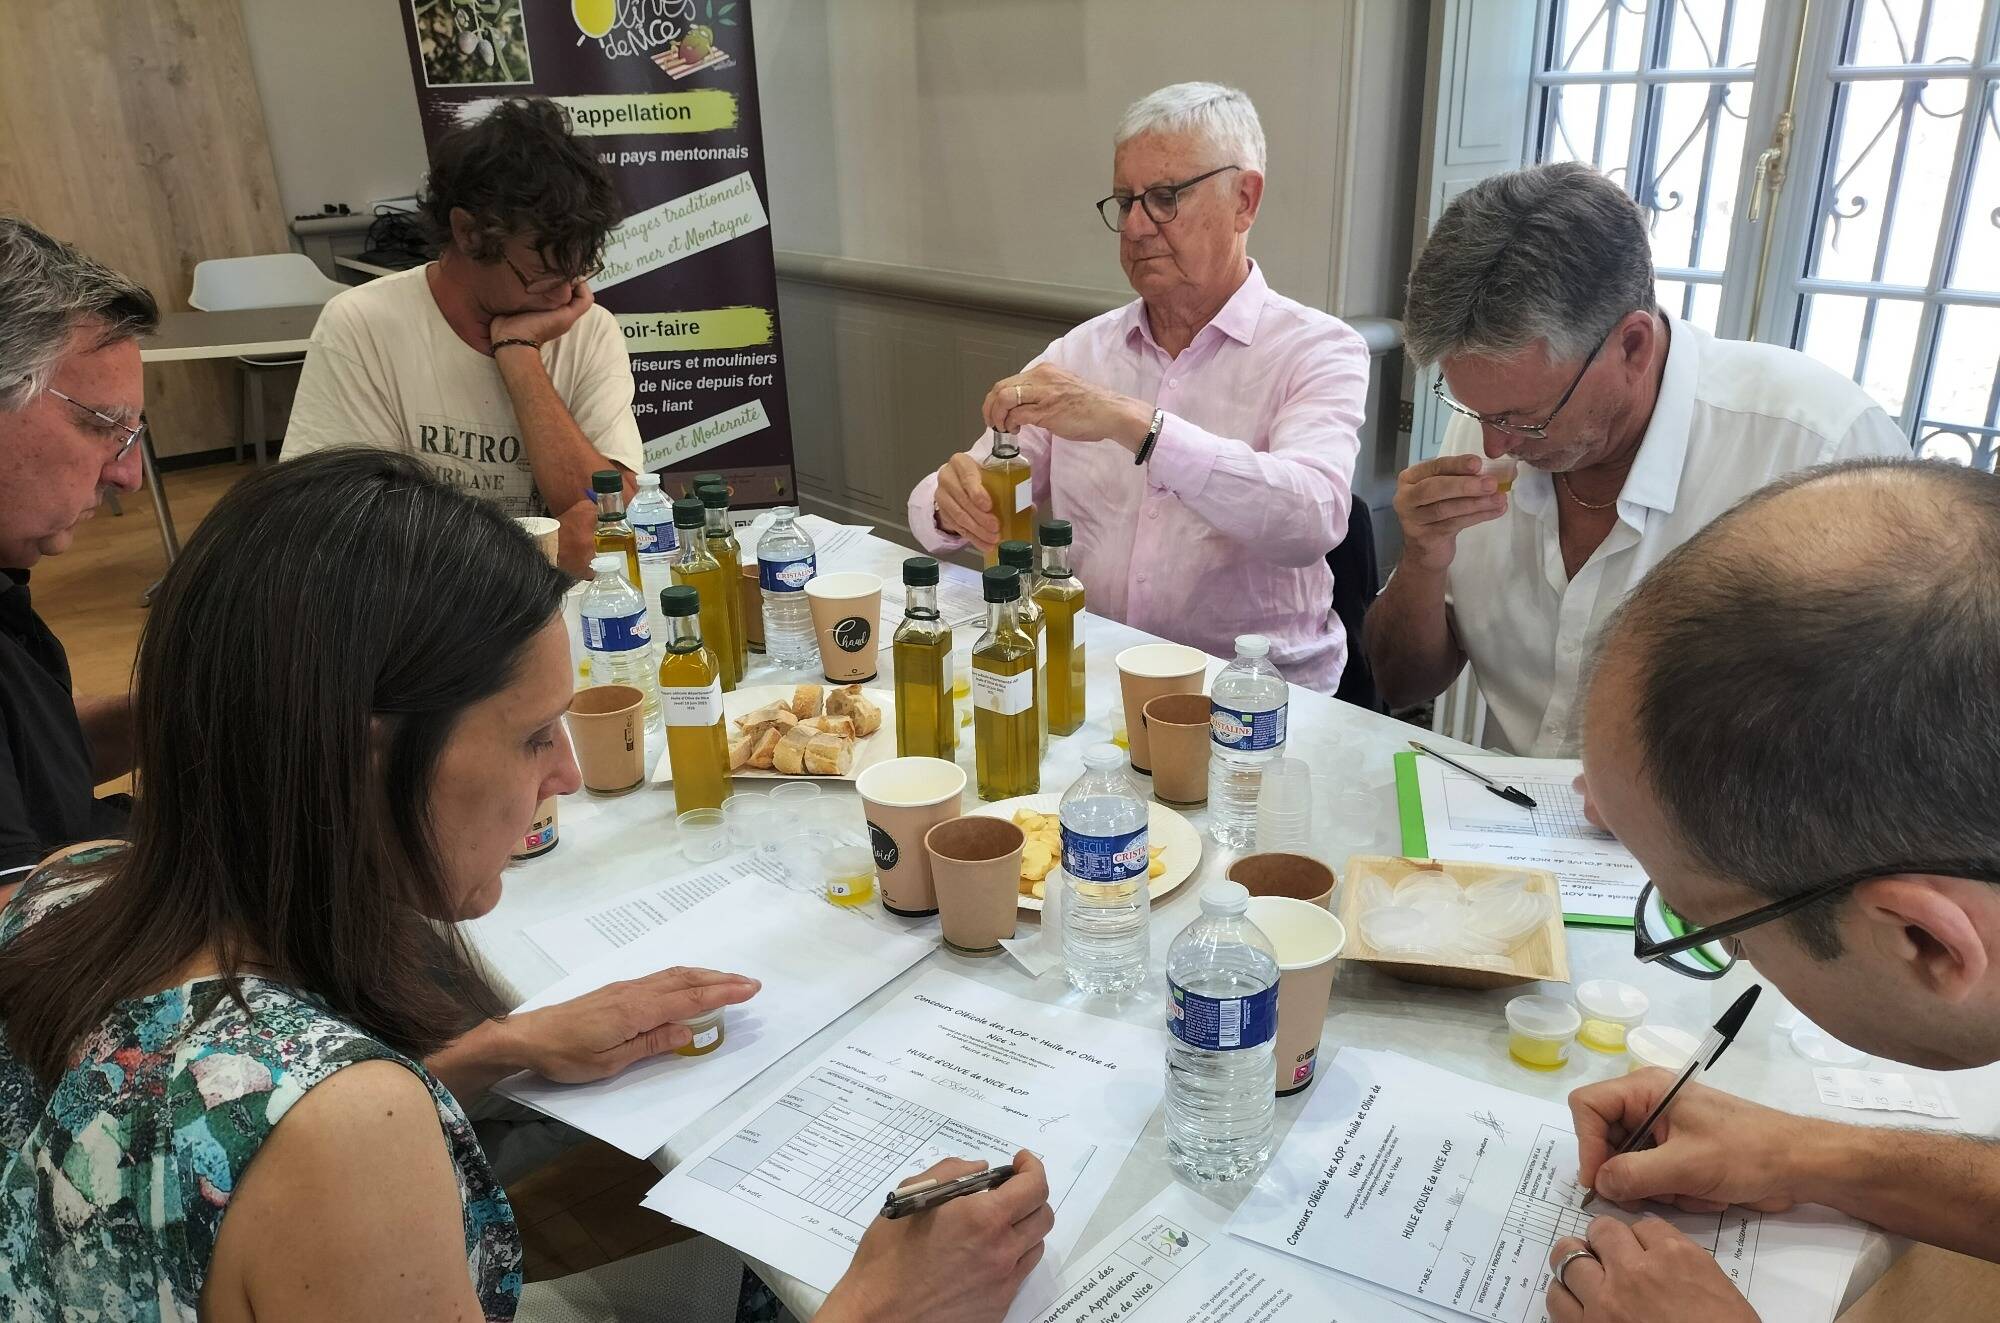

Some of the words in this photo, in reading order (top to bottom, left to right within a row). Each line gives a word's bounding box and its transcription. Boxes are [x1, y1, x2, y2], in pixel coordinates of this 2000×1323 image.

[620, 150, 657, 166] pays
[661, 145, 749, 161] mentonnais
[662, 177, 752, 224] traditionnels
[637, 248, 666, 267] mer
[668, 236, 683, 254] et
[684, 212, 752, 251] Montagne
[620, 319, 700, 338] oir-faire
[631, 358, 681, 372] fiseurs
[685, 356, 699, 369] et
[703, 353, 777, 368] mouliniers
[639, 380, 656, 392] de
[661, 378, 692, 392] Nice
[696, 374, 743, 391] depuis
[748, 373, 773, 386] fort
[662, 400, 693, 413] liant
[419, 424, 521, 463] RETRO
[643, 445, 672, 466] tion
[675, 434, 690, 449] et
[692, 406, 761, 448] Modernité
[824, 620, 867, 648] Chaud
[914, 994, 953, 1012] Concours
[954, 1008, 988, 1025] Oléicole
[989, 1021, 1005, 1031] des
[1005, 1028, 1030, 1038] AOP
[1040, 1038, 1064, 1052] Huile
[1065, 1048, 1077, 1056] et
[1078, 1052, 1103, 1065] Olive
[1104, 1061, 1117, 1070] de
[986, 1033, 1007, 1045] Nice
[906, 1048, 934, 1062] HUILE
[936, 1059, 969, 1075] d'OLIVE
[970, 1071, 982, 1080] de
[983, 1077, 1005, 1089] NICE
[1007, 1086, 1030, 1097] AOP
[1370, 1085, 1381, 1094] de
[1361, 1094, 1376, 1111] Olive
[1357, 1111, 1366, 1120] et
[1345, 1120, 1362, 1139] Huile
[1332, 1146, 1346, 1165] AOP
[1440, 1139, 1453, 1156] AOP
[1324, 1165, 1337, 1179] des
[1348, 1161, 1363, 1178] Nice
[1390, 1156, 1403, 1171] Vence
[1432, 1156, 1447, 1175] NICE
[1386, 1172, 1395, 1180] de
[1427, 1175, 1438, 1185] de
[747, 1189, 762, 1198] note
[1307, 1179, 1329, 1208] Oléicole
[1377, 1180, 1391, 1197] Mairie
[1413, 1185, 1434, 1214] d'OLIVE
[828, 1227, 842, 1236] Mon
[1287, 1209, 1313, 1246] Concours
[1402, 1214, 1420, 1240] HUILE
[1444, 1219, 1454, 1232] NOM
[1098, 1265, 1115, 1281] des
[1420, 1268, 1433, 1285] TABLE
[1478, 1281, 1490, 1303] INTENSITE
[1486, 1274, 1493, 1282] DE
[1491, 1240, 1506, 1268] PERCEPTION
[1089, 1270, 1139, 1314] Appellation
[1454, 1268, 1471, 1299] ECHANTILLON
[1120, 1300, 1133, 1313] de
[1132, 1282, 1154, 1302] Nice
